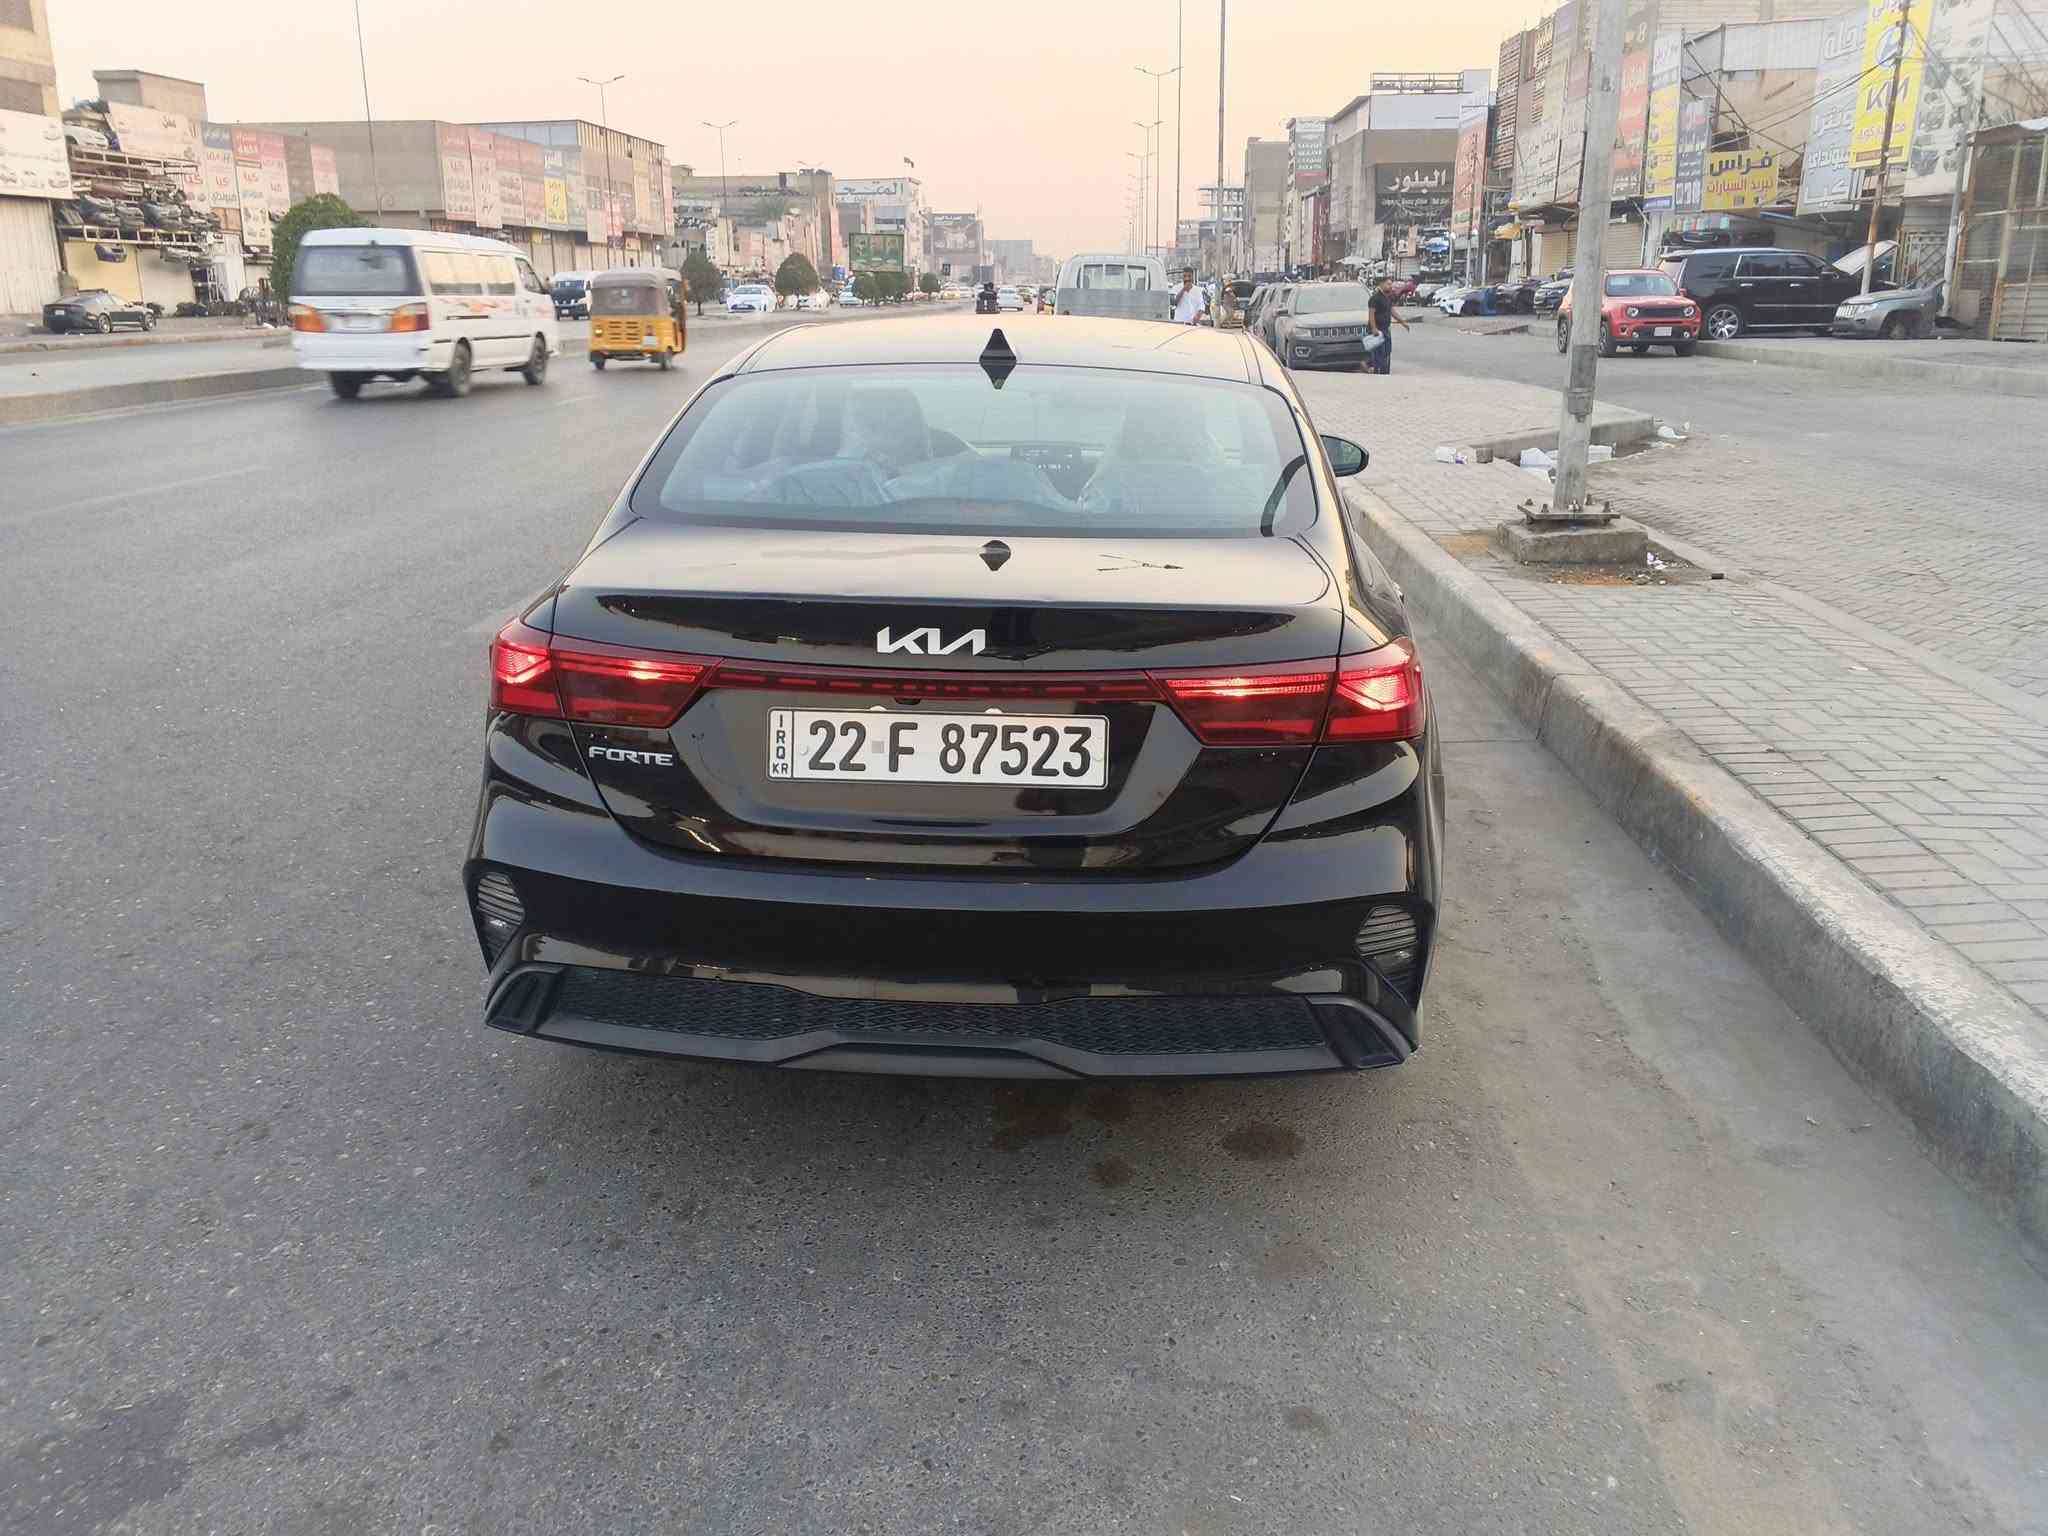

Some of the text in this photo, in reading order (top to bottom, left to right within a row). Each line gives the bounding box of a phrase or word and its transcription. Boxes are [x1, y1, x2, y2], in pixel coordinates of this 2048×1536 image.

[1709, 151, 1773, 176] فراس
[1383, 167, 1447, 194] البلور
[877, 626, 986, 656] KIA
[588, 746, 673, 766] FORTE
[808, 719, 1092, 778] 22 F 87523
